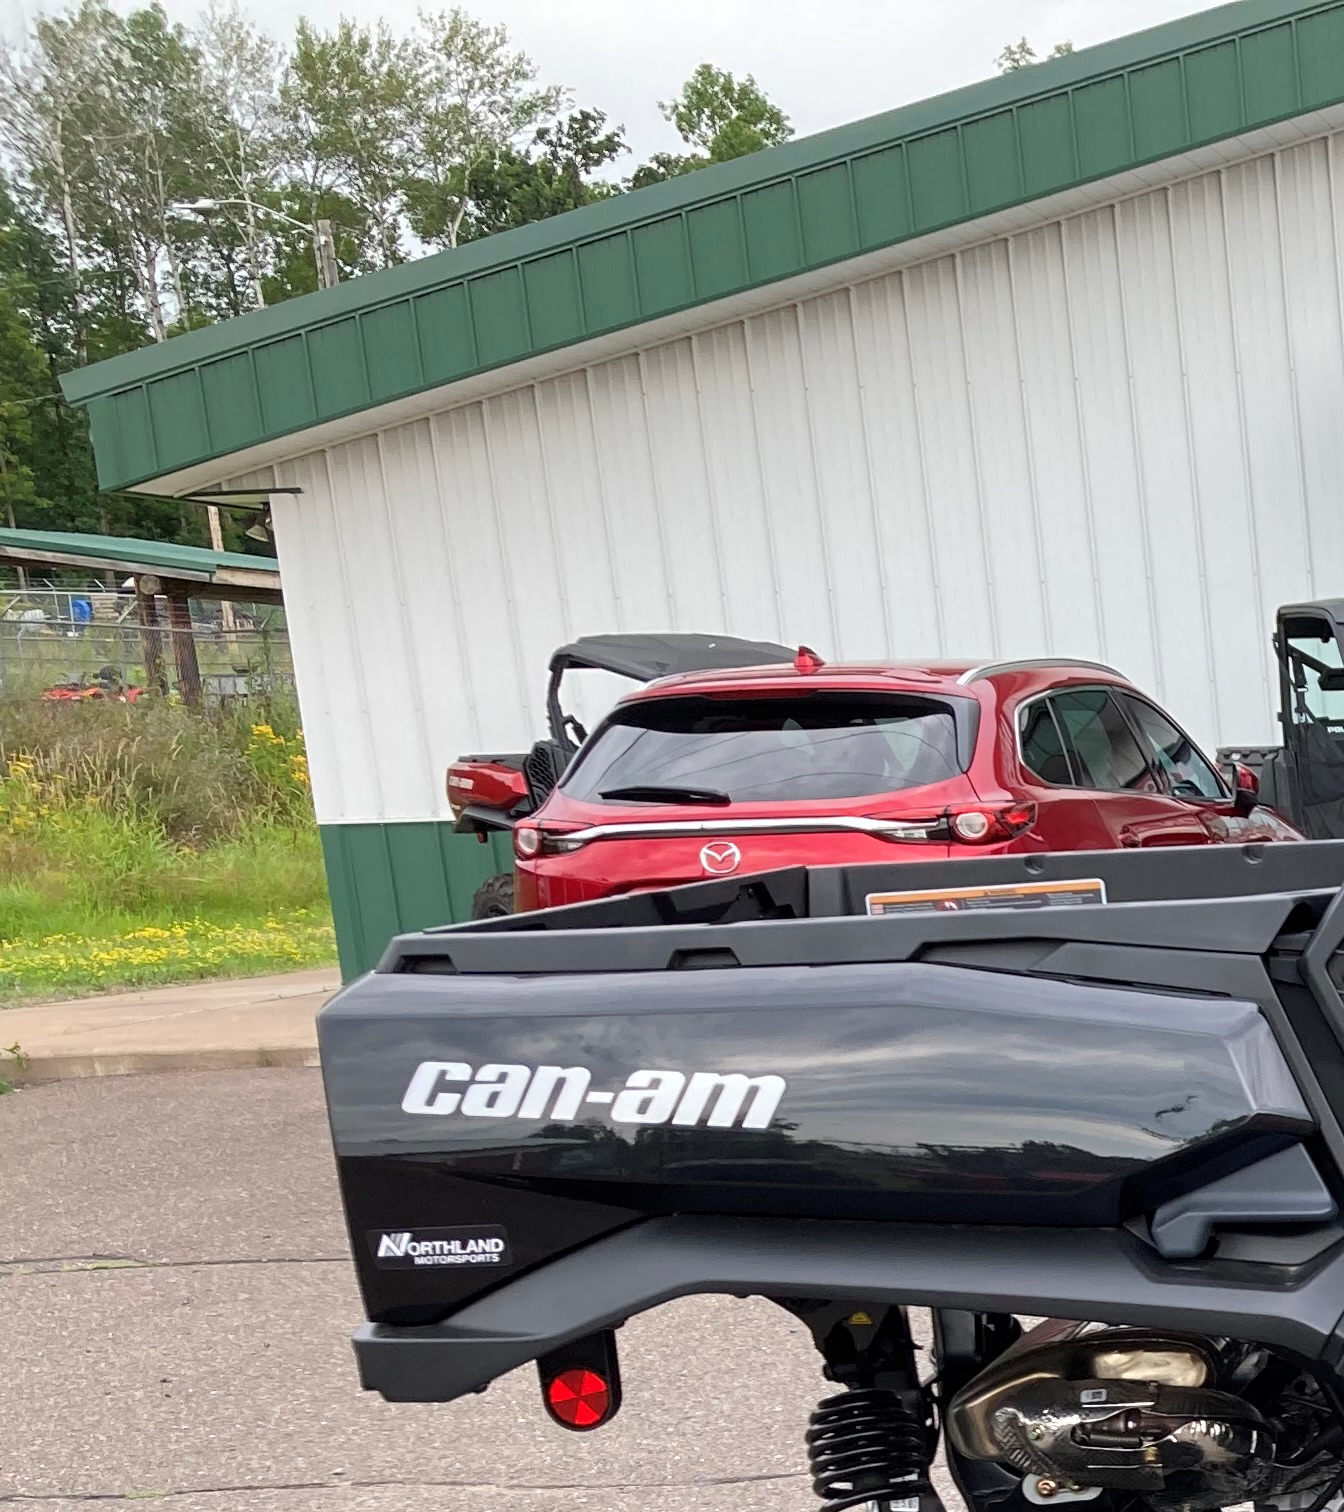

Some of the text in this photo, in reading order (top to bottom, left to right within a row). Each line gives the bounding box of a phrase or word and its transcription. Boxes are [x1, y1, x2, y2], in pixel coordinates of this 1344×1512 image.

[401, 1058, 786, 1130] can-am
[377, 1232, 505, 1257] NORTHLAND
[414, 1253, 500, 1265] MOTORSPORTS
